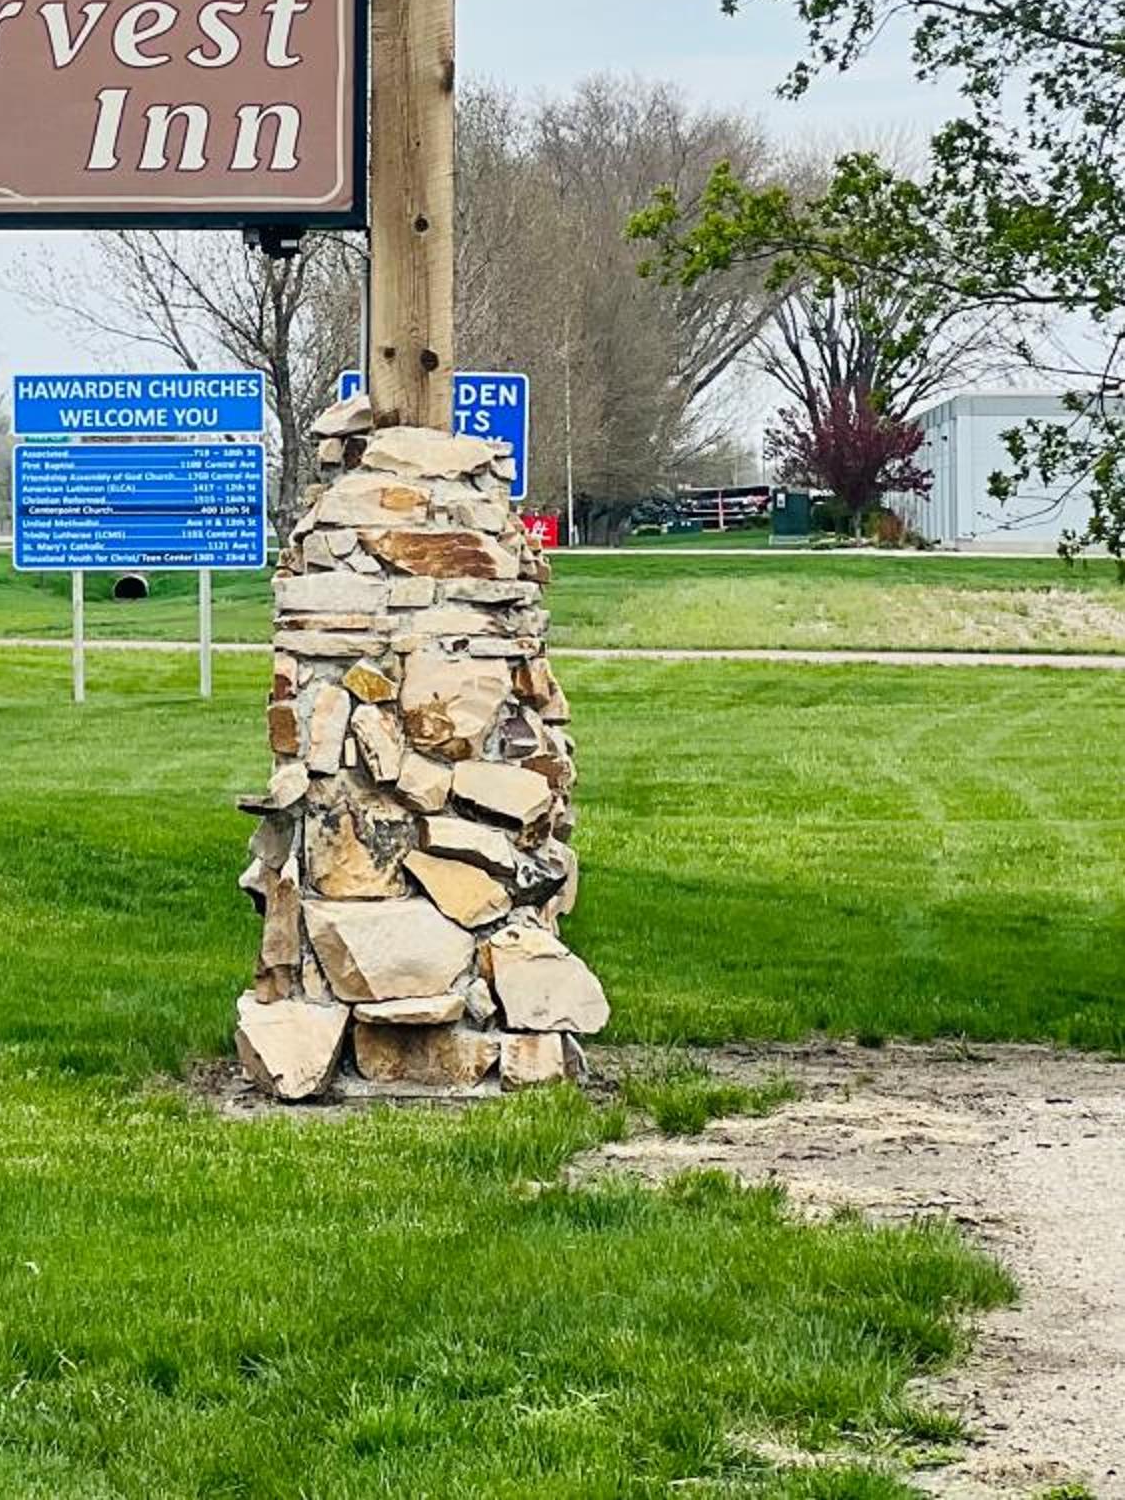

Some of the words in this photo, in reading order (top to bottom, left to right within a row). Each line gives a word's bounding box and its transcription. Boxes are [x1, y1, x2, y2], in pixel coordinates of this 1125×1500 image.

[87, 88, 302, 171] Inn
[18, 381, 142, 399] HAWARDEN
[148, 379, 260, 398] CHURCHES
[59, 408, 168, 428] WELCOME
[172, 408, 219, 427] YOU
